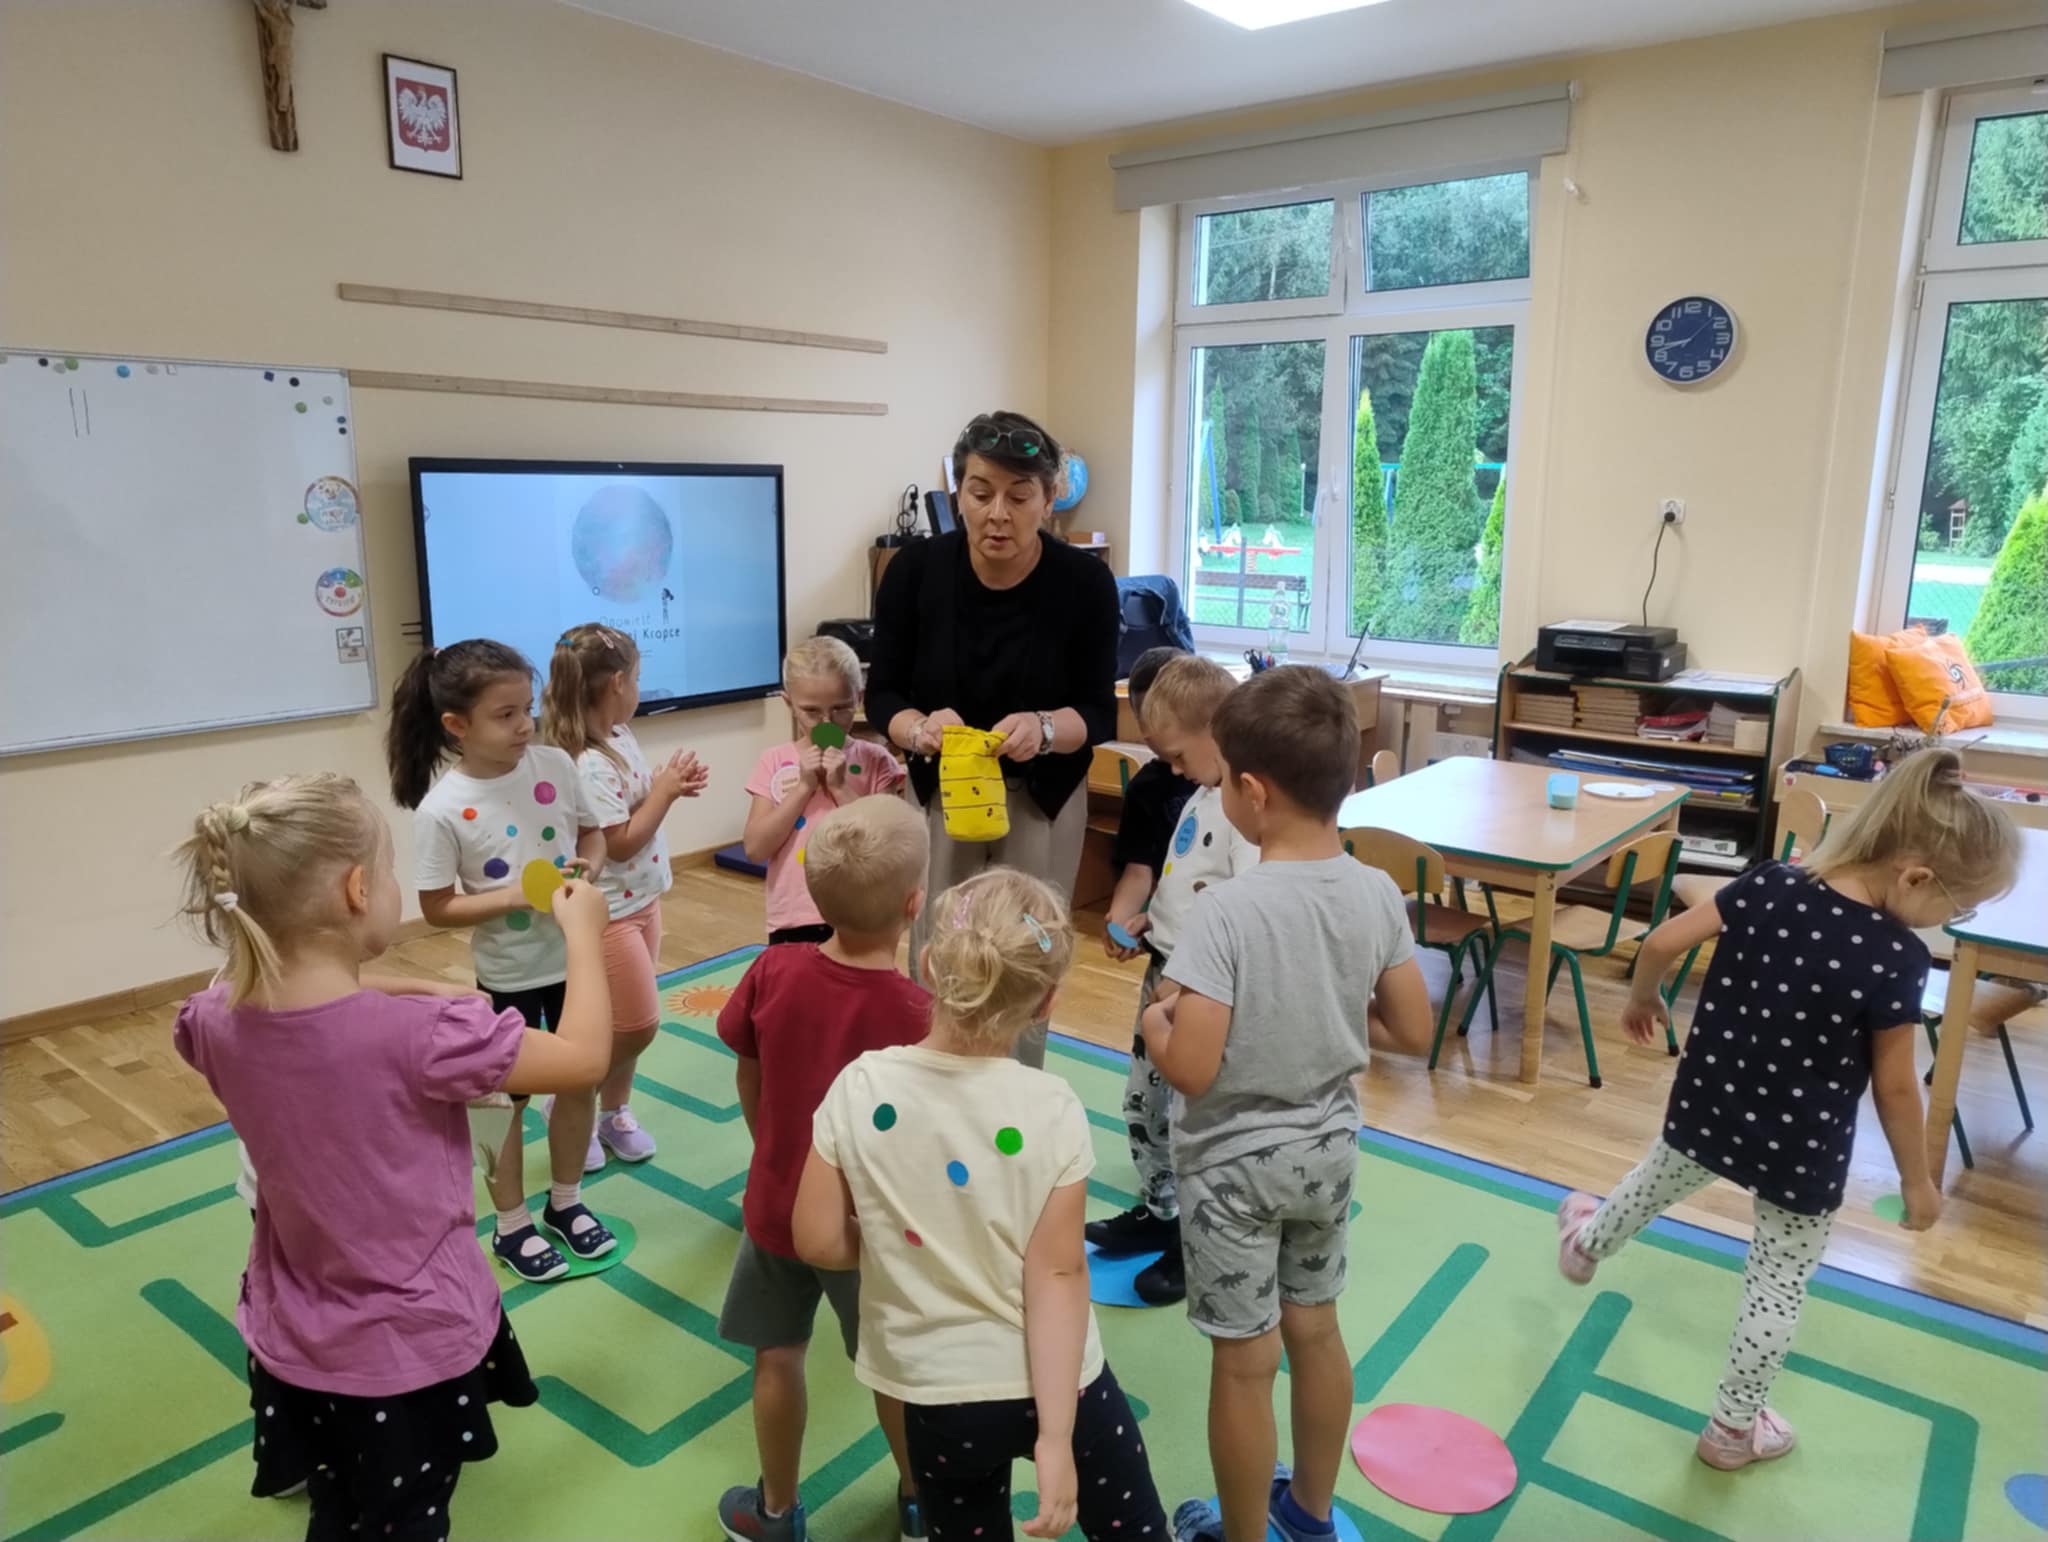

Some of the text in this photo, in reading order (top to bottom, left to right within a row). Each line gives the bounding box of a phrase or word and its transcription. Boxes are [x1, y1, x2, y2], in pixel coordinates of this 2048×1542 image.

[1671, 307, 1682, 319] 11
[1685, 301, 1702, 314] 12
[1707, 305, 1712, 318] 1
[1655, 319, 1673, 332] 10
[1712, 316, 1728, 329] 2
[1650, 335, 1665, 348] 9
[1715, 332, 1731, 345] 3
[1654, 350, 1668, 362] 8
[1710, 348, 1724, 360] 4
[1664, 361, 1679, 374] 7
[1679, 365, 1694, 379] 6
[1696, 360, 1712, 373] 5
